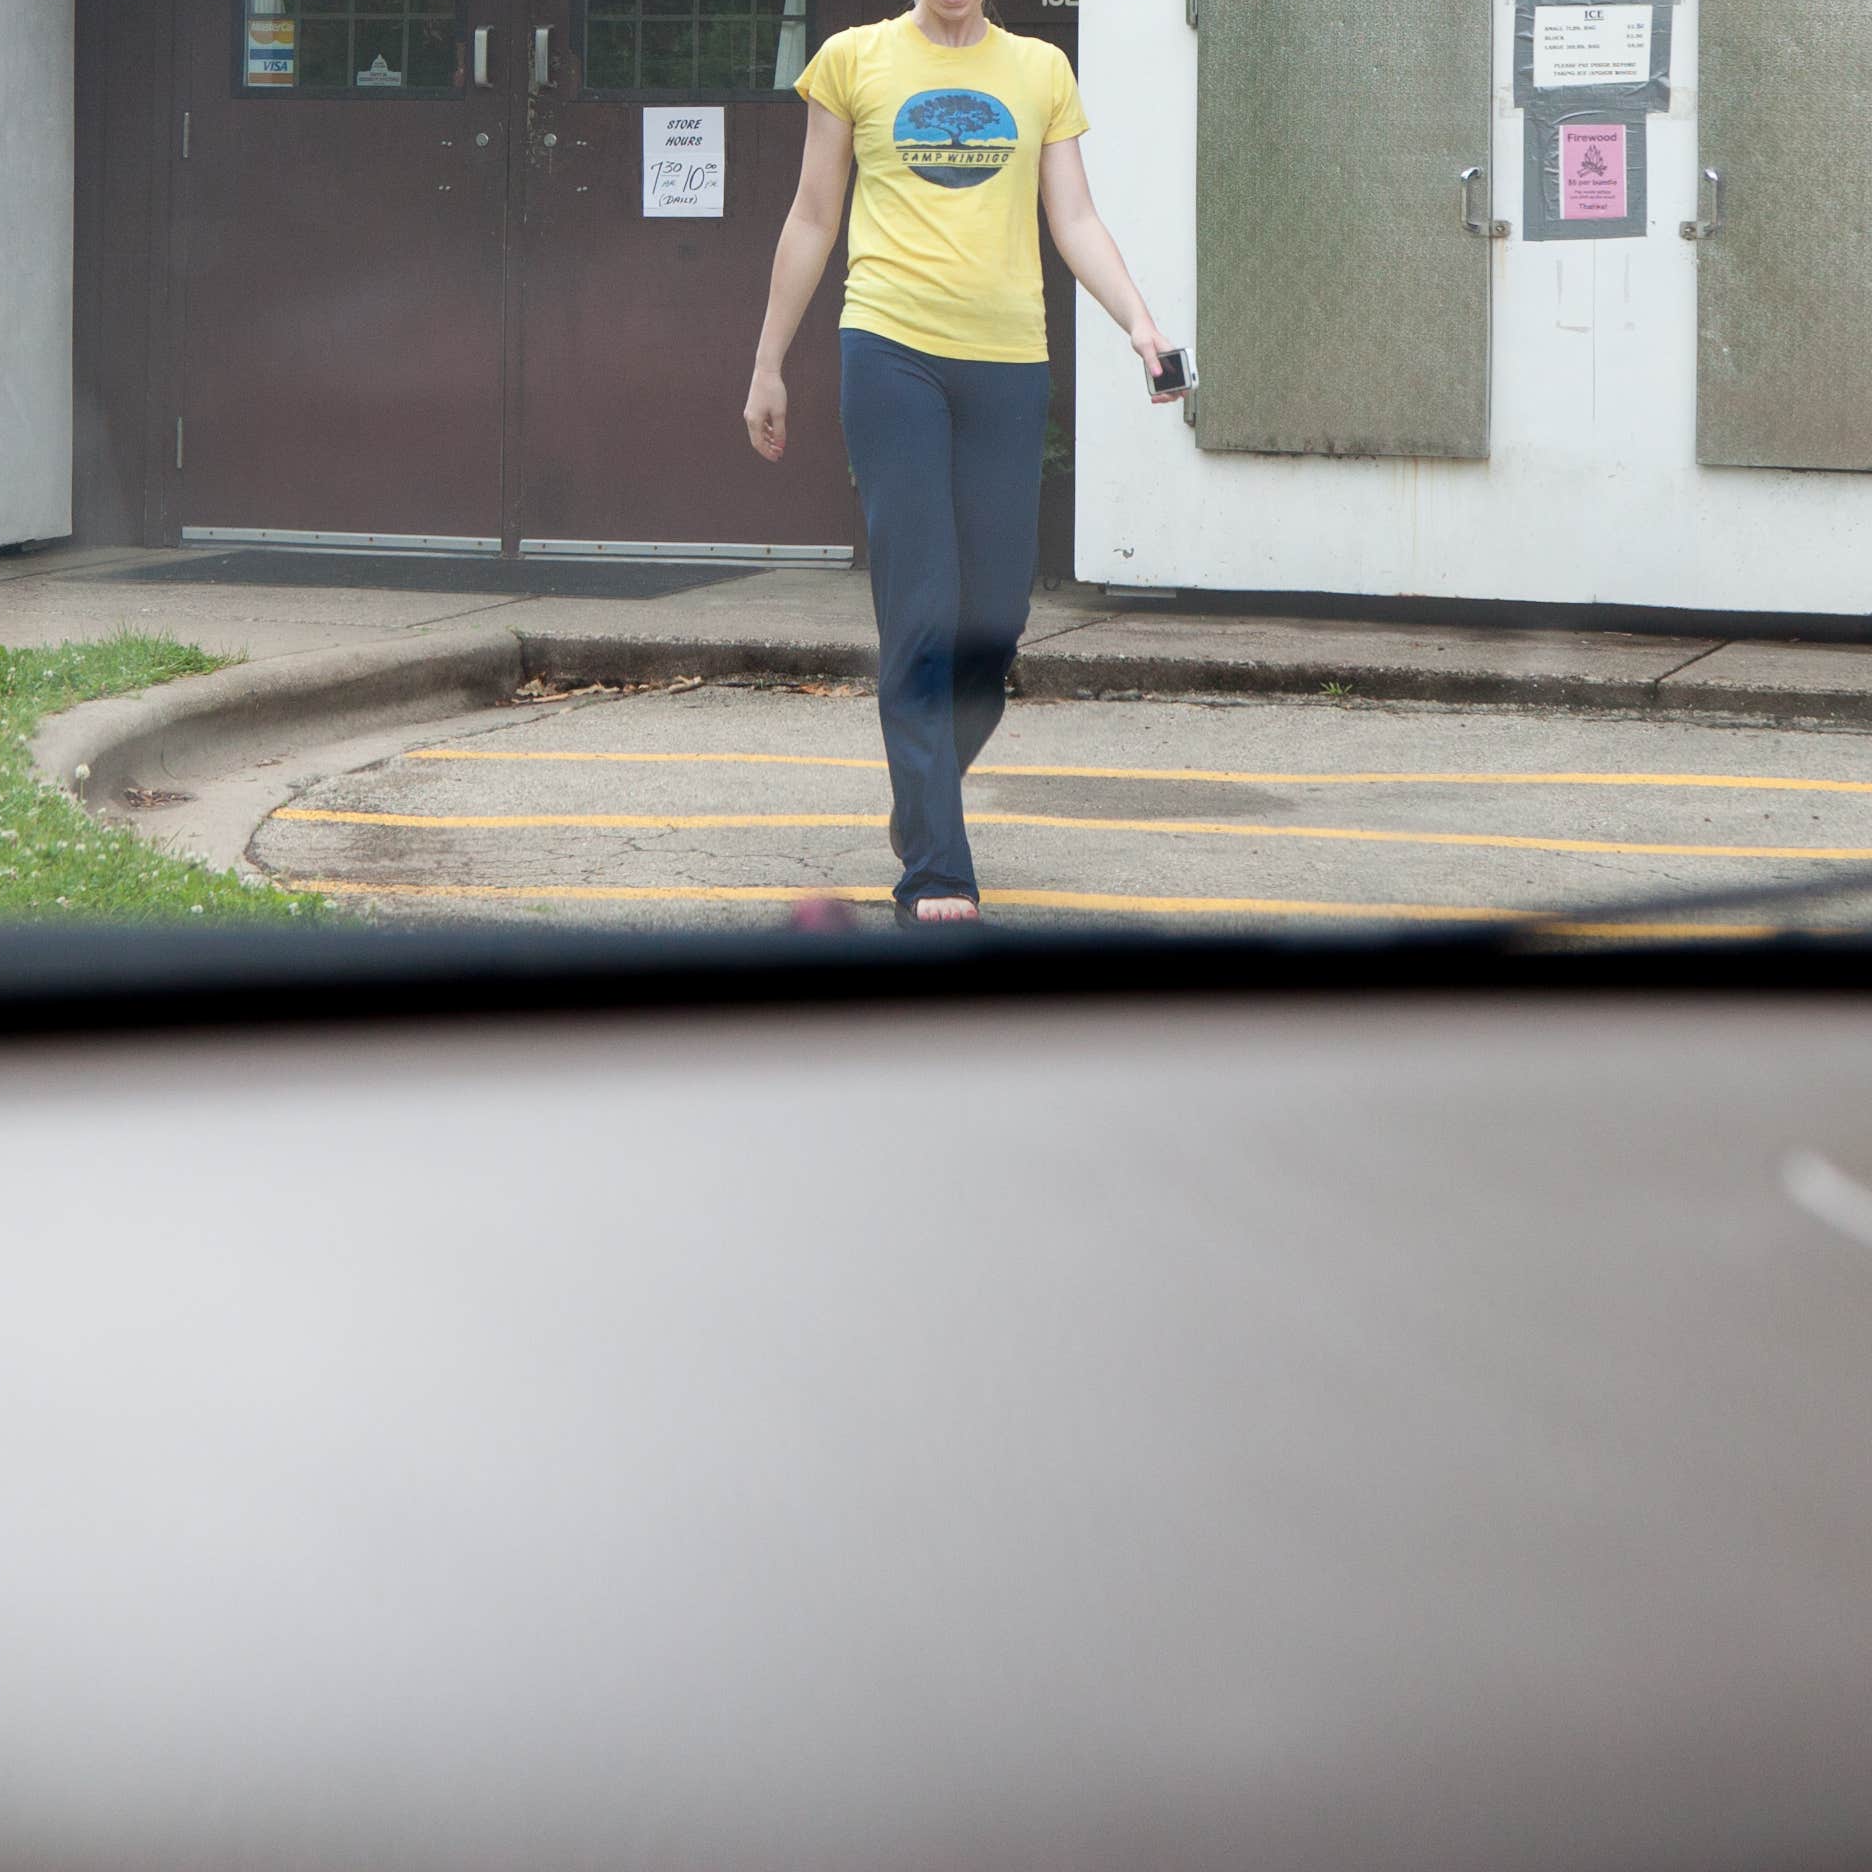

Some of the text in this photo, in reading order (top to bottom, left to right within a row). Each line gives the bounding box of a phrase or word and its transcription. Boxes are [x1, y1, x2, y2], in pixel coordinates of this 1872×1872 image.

[1584, 9, 1603, 20] ICE
[263, 61, 288, 71] VISA
[667, 119, 702, 129] STORE
[665, 136, 703, 146] HOURS
[1568, 132, 1617, 142] Firewood
[902, 153, 1009, 163] CAMP WINDIGO
